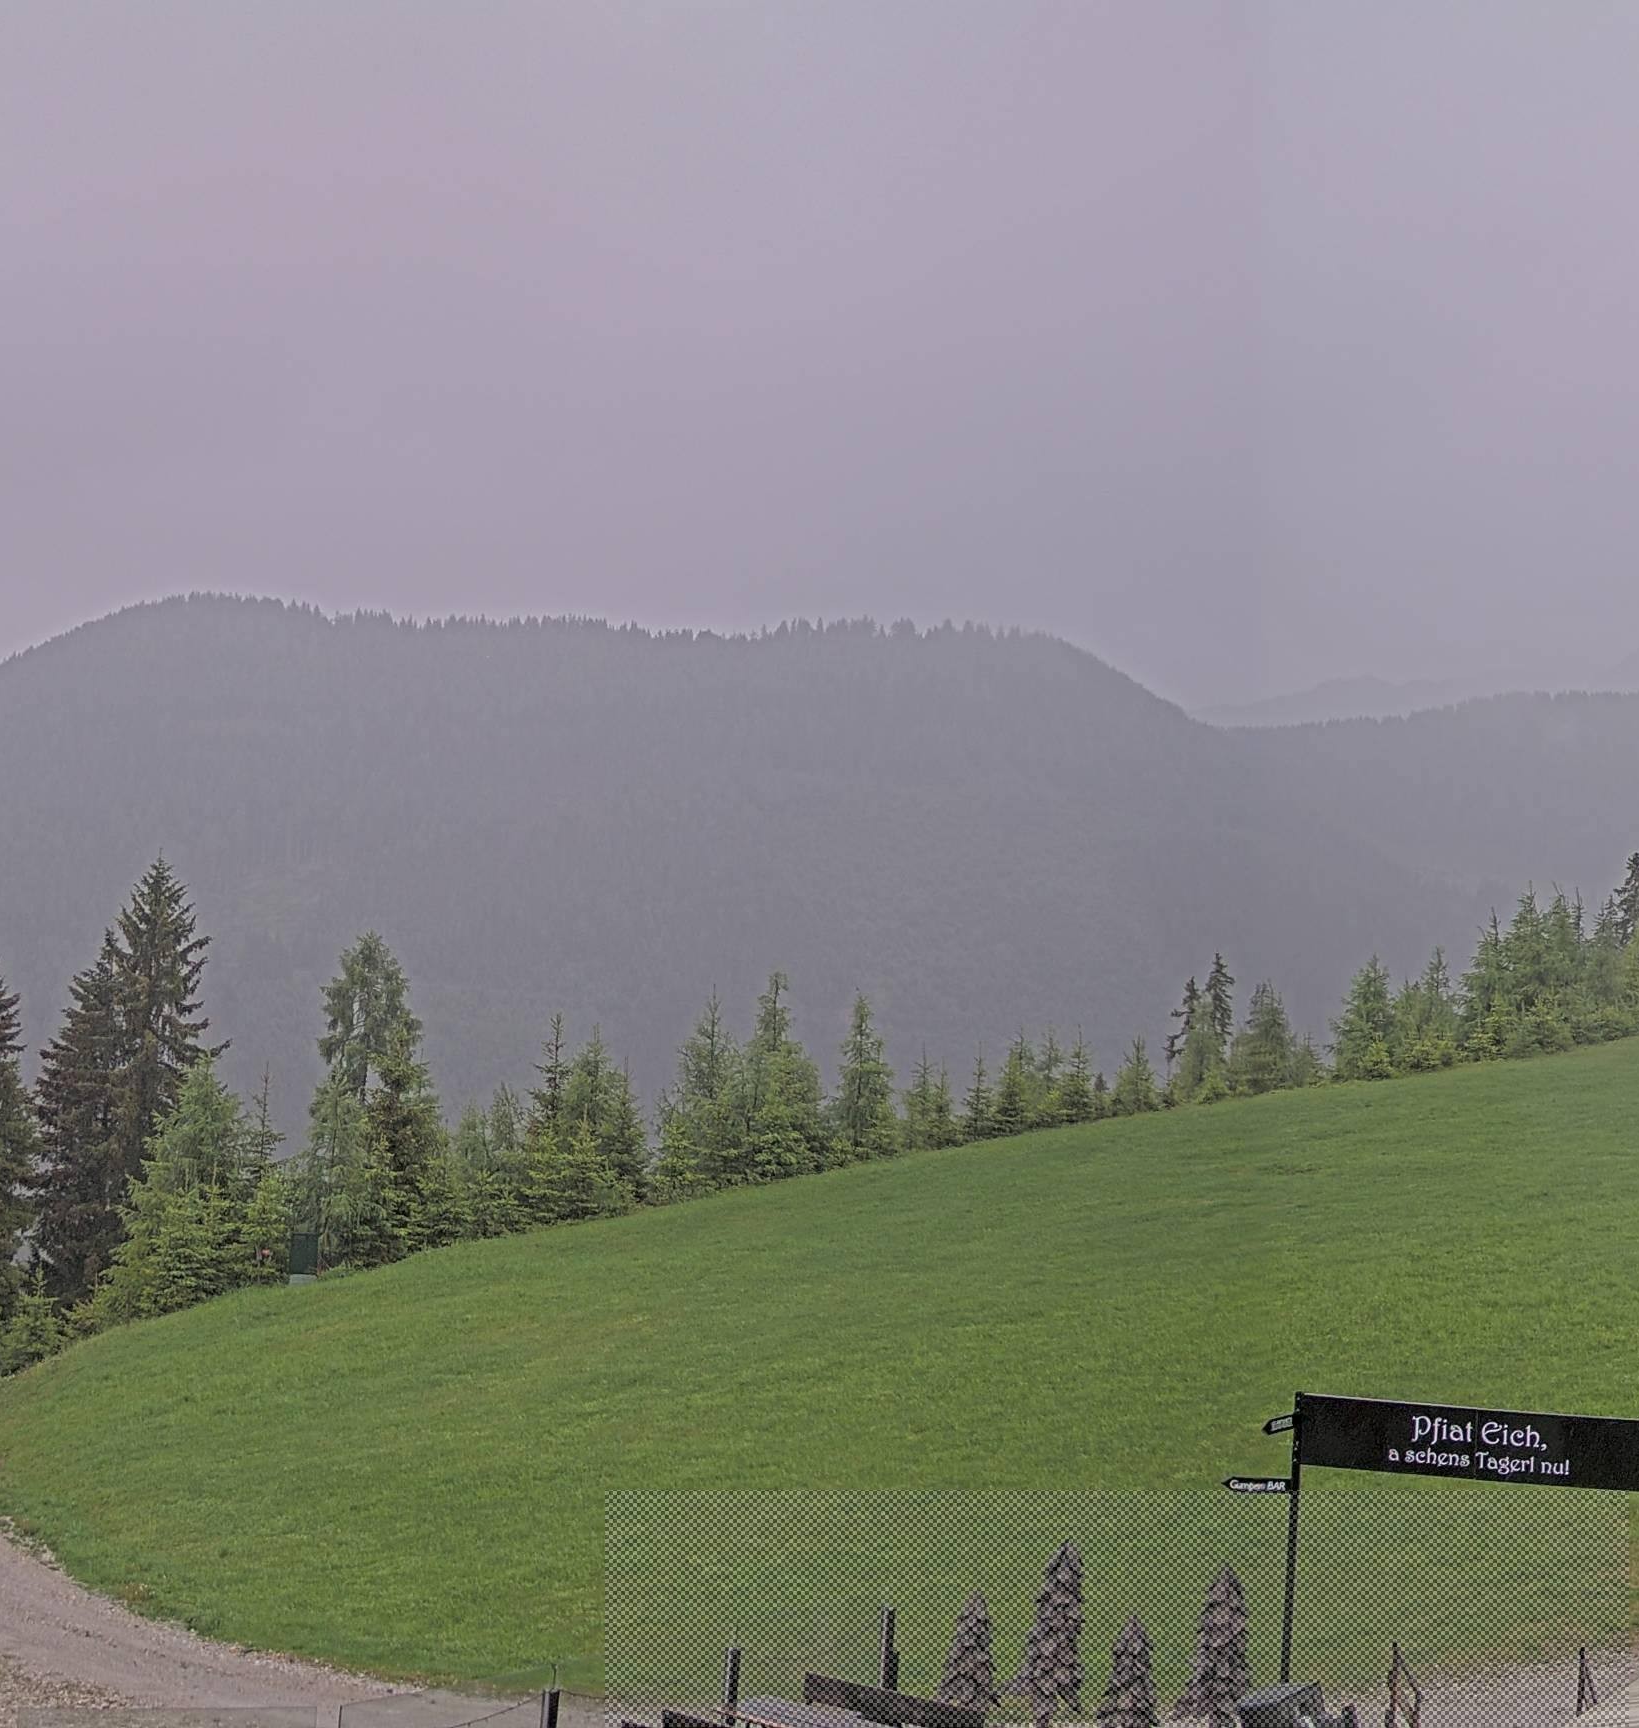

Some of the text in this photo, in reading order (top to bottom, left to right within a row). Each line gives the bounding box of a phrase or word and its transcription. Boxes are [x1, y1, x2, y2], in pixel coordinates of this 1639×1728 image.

[1411, 1415, 1548, 1451] Pfiat Eich,
[1388, 1447, 1570, 1475] a schens Tagerl nu!
[1266, 1480, 1286, 1491] BAR
